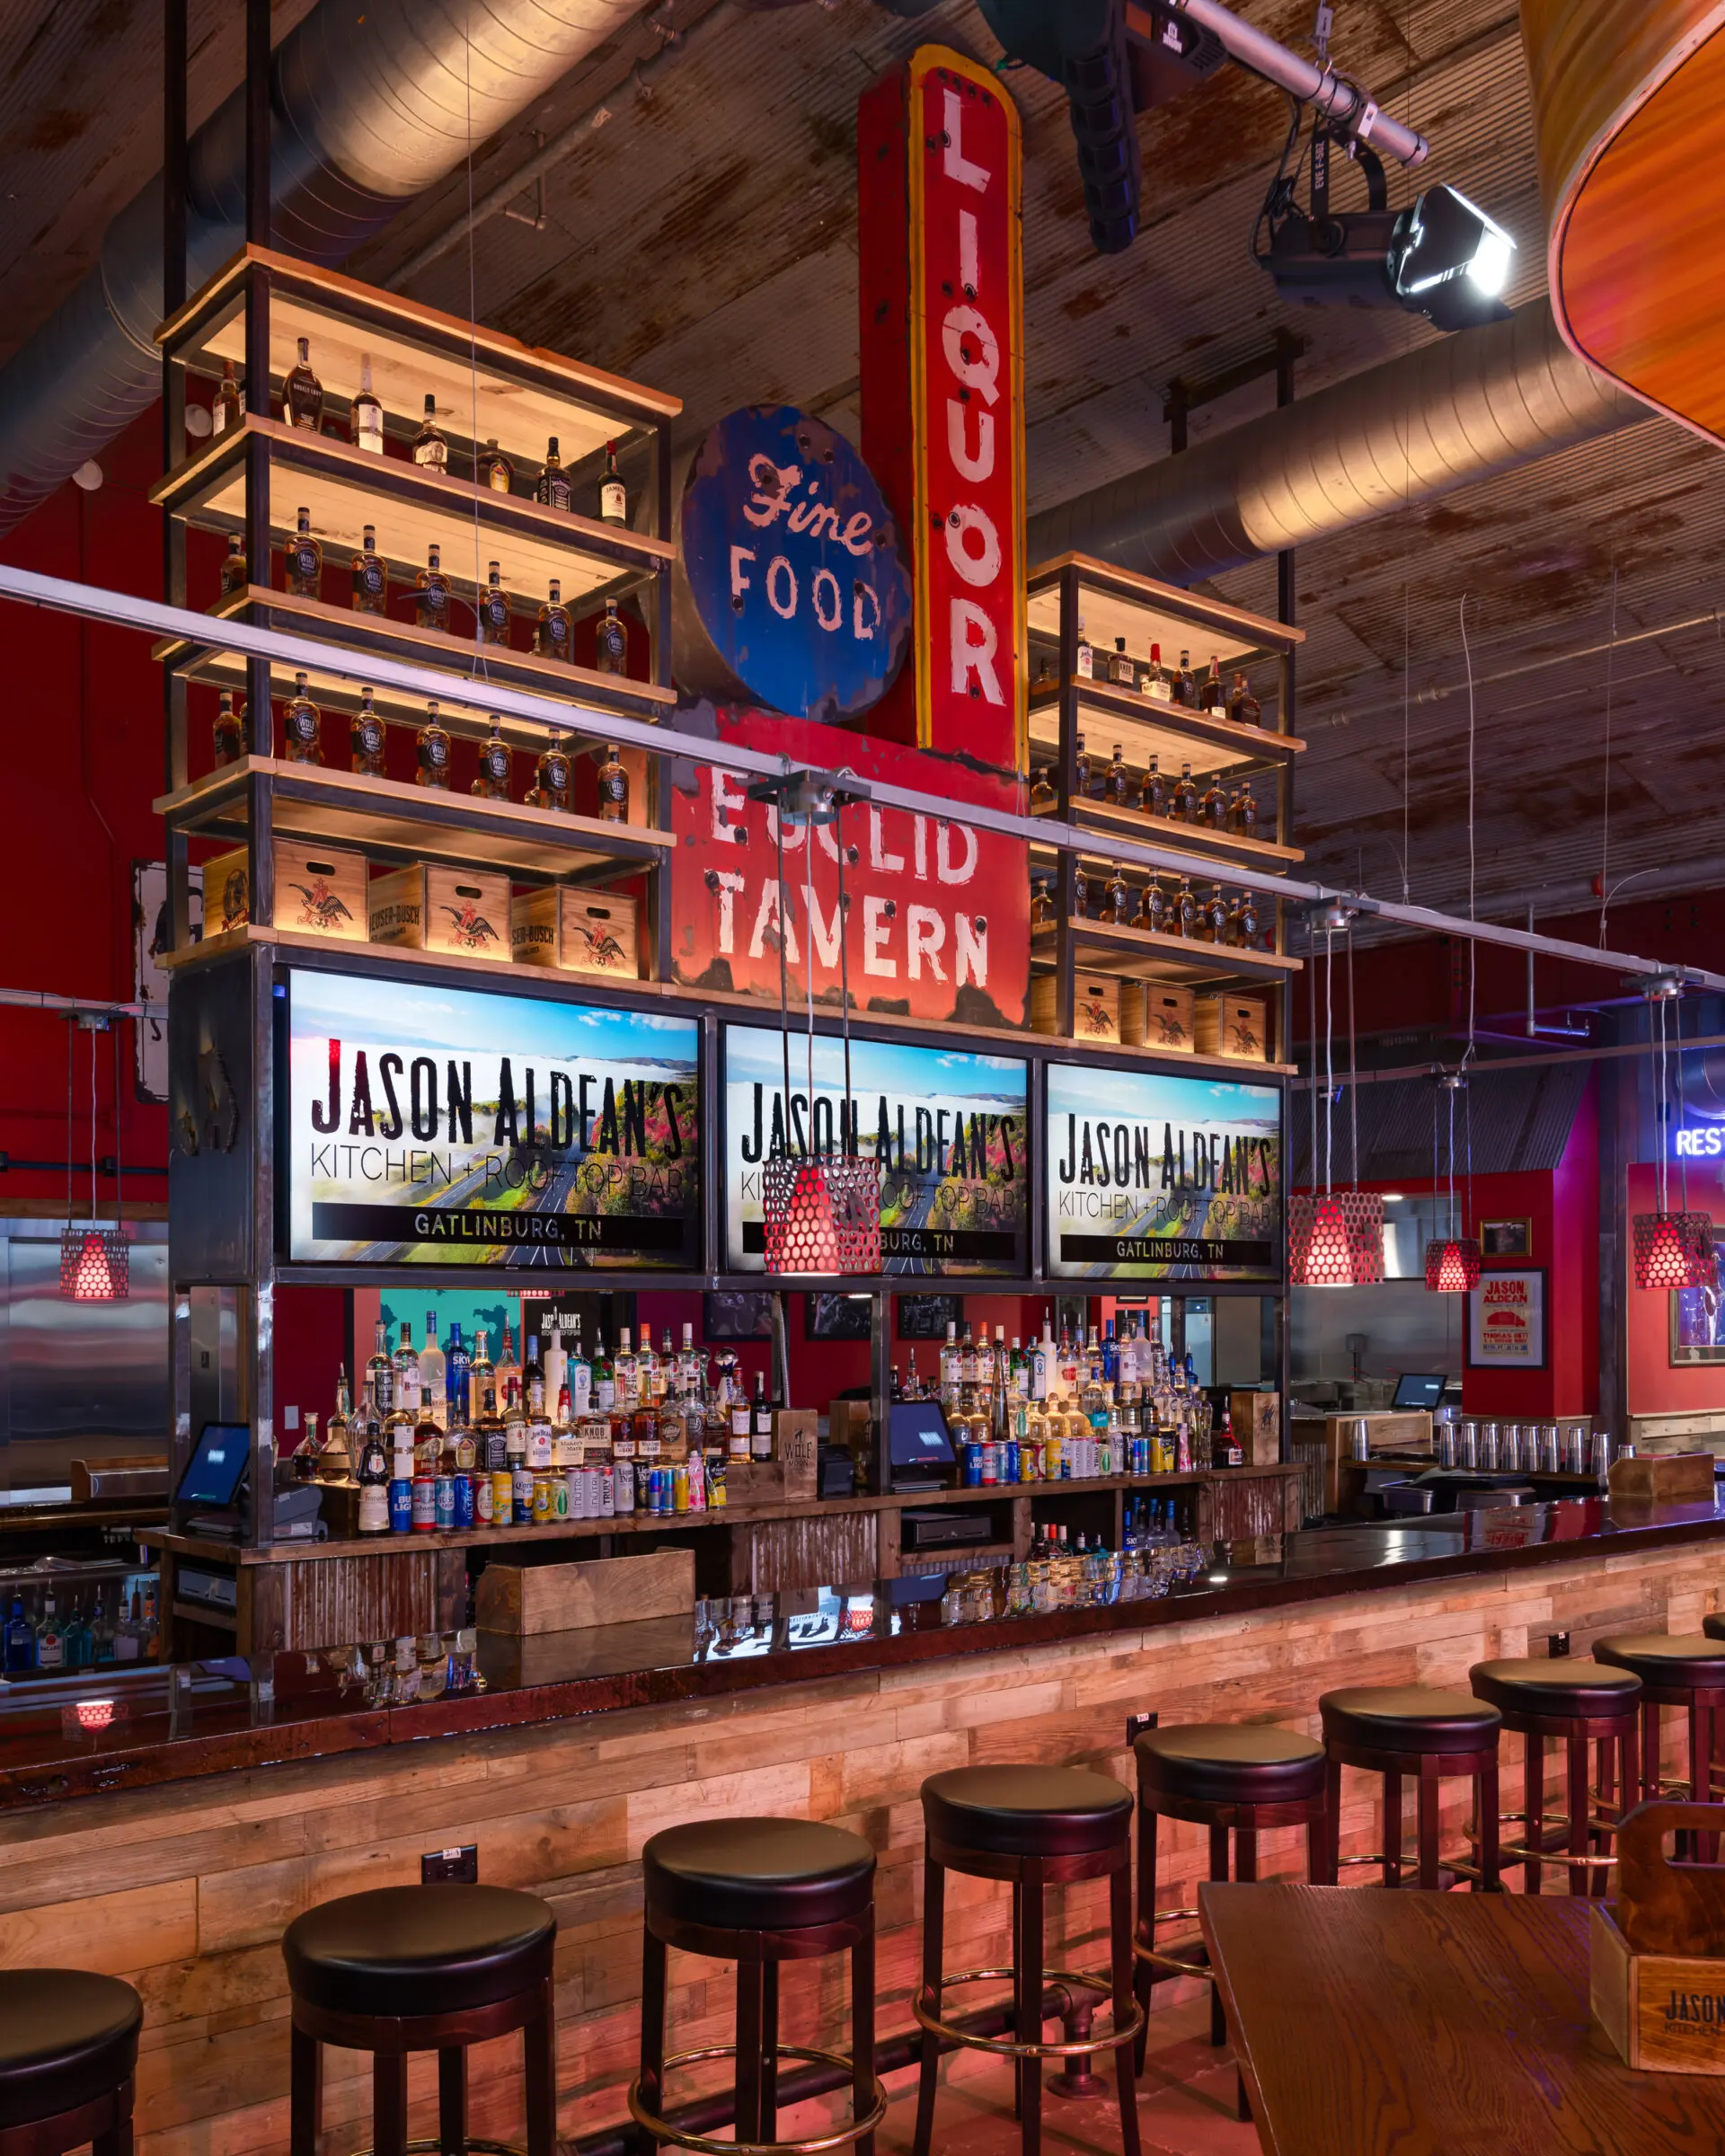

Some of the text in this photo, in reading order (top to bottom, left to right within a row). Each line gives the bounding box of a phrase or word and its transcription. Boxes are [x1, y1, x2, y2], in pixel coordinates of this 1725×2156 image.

[942, 88, 1006, 707] LIQUOR
[742, 454, 873, 557] Fine
[730, 543, 881, 640] FOOD
[703, 867, 988, 988] TAVERN
[311, 1038, 684, 1161] JASON ALDEAN'S
[741, 1082, 1015, 1182] JASON ALDEAN'S
[1676, 1127, 1725, 1156] RES
[311, 1144, 683, 1198] KITCHEN + ROOFTOP BAR
[1059, 1113, 1271, 1197] JASON ALDEAN'S
[881, 1180, 1014, 1214] OOFTOP BAR
[1059, 1190, 1271, 1226] KITCHEN + ROOFTOP BAR
[415, 1213, 602, 1241] GATLINBURG, TN
[1117, 1241, 1224, 1260] GATLINBURG, TN
[1483, 1294, 1528, 1303] ALDEAN
[1487, 1281, 1525, 1294] JASON
[584, 1427, 605, 1436] KNOB
[784, 1442, 812, 1461] WOLF
[789, 1459, 809, 1467] MOON
[603, 1479, 611, 1505] TRULY
[1665, 1990, 1725, 2026] JASON
